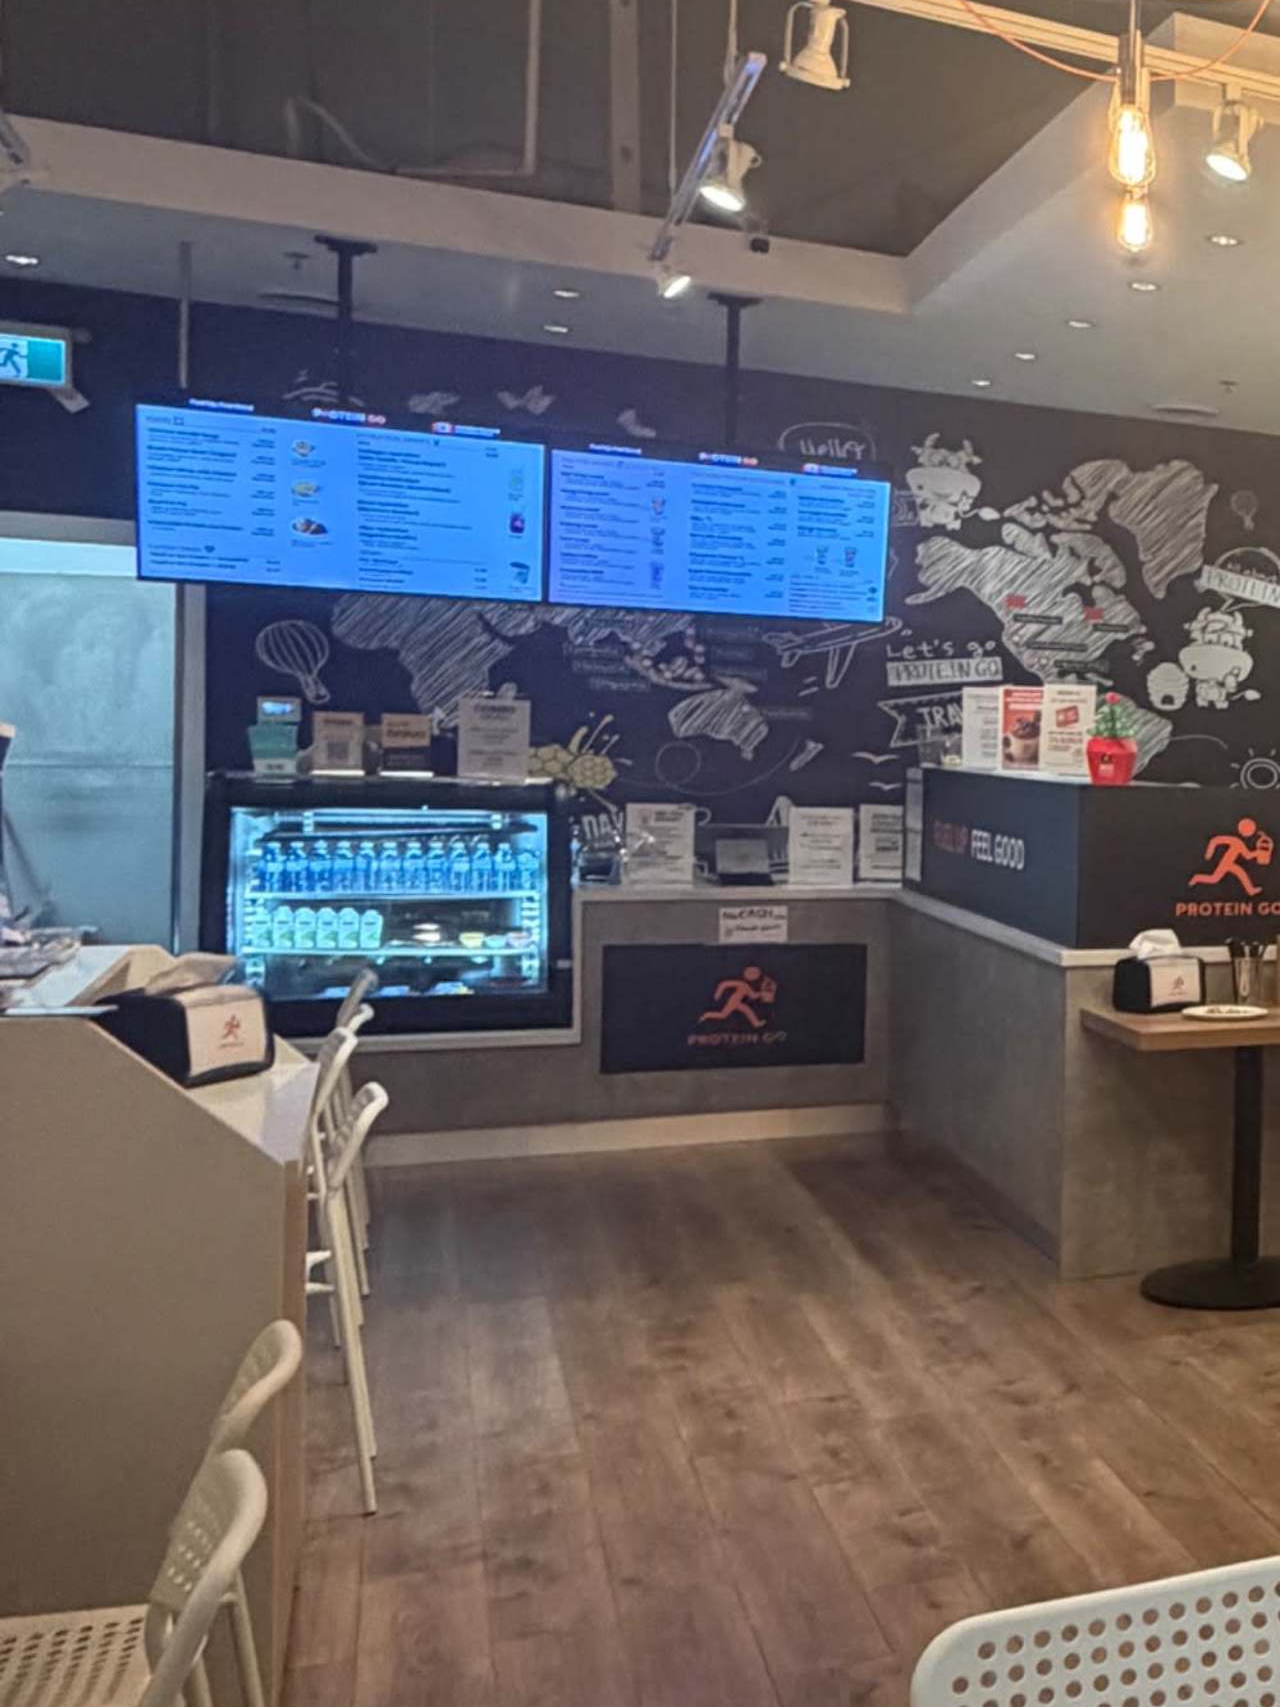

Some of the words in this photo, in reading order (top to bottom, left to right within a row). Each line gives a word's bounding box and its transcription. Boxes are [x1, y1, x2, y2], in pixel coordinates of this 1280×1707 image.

[886, 639, 954, 659] Let's
[967, 640, 997, 660] go
[971, 829, 993, 862] FEEL
[995, 834, 1025, 870] GOOD
[1175, 901, 1252, 916] PROTEIN
